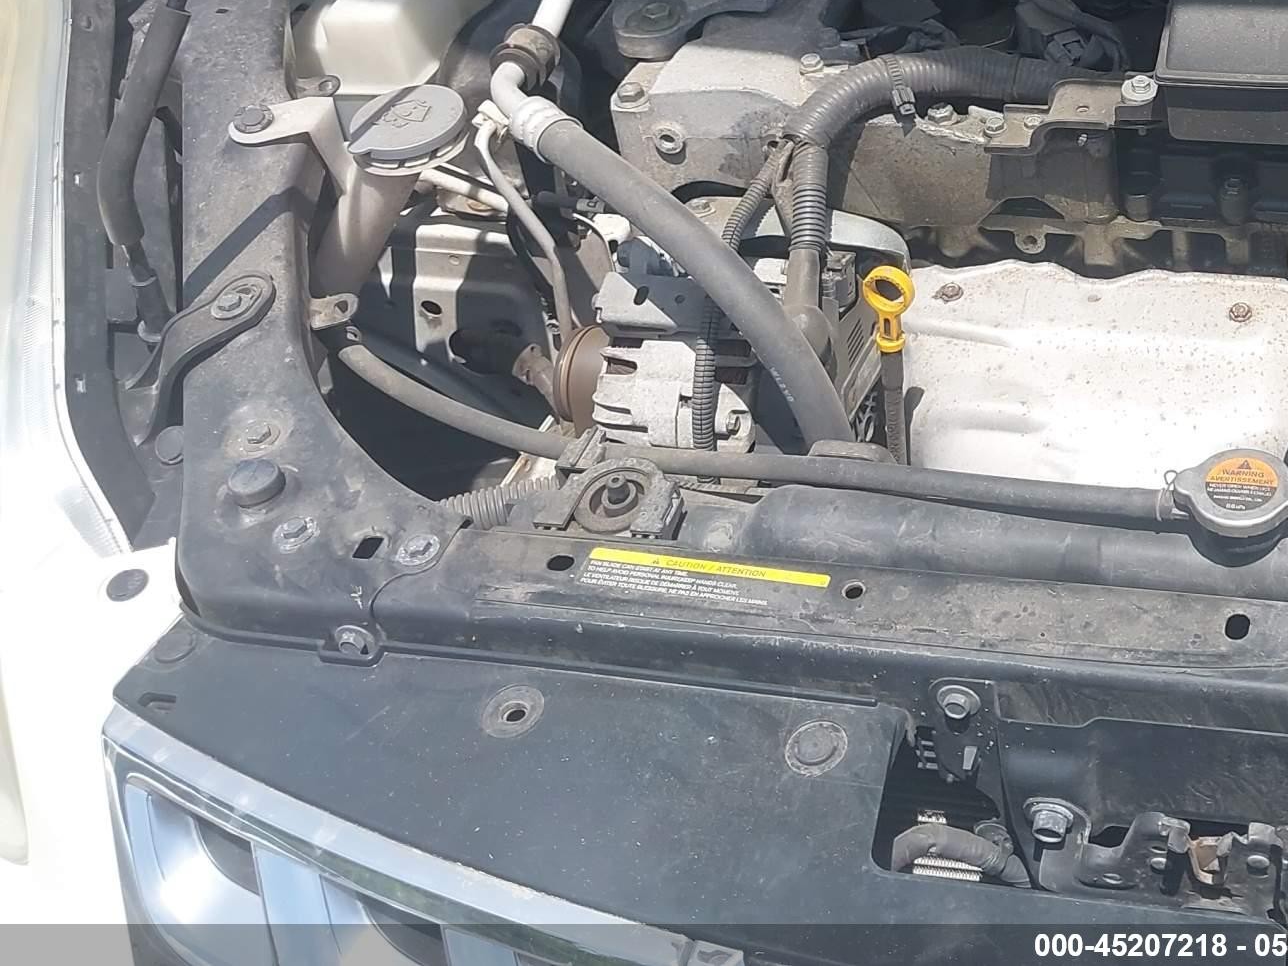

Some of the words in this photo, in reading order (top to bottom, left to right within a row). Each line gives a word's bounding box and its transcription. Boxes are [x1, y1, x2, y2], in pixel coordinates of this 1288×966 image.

[1222, 469, 1265, 478] WARNING
[1210, 475, 1274, 485] AVERTISSEMENT
[665, 559, 706, 570] CAUTION
[716, 566, 767, 578] ATTENTION
[630, 570, 661, 579] PERSONAL
[696, 577, 716, 585] HANDS
